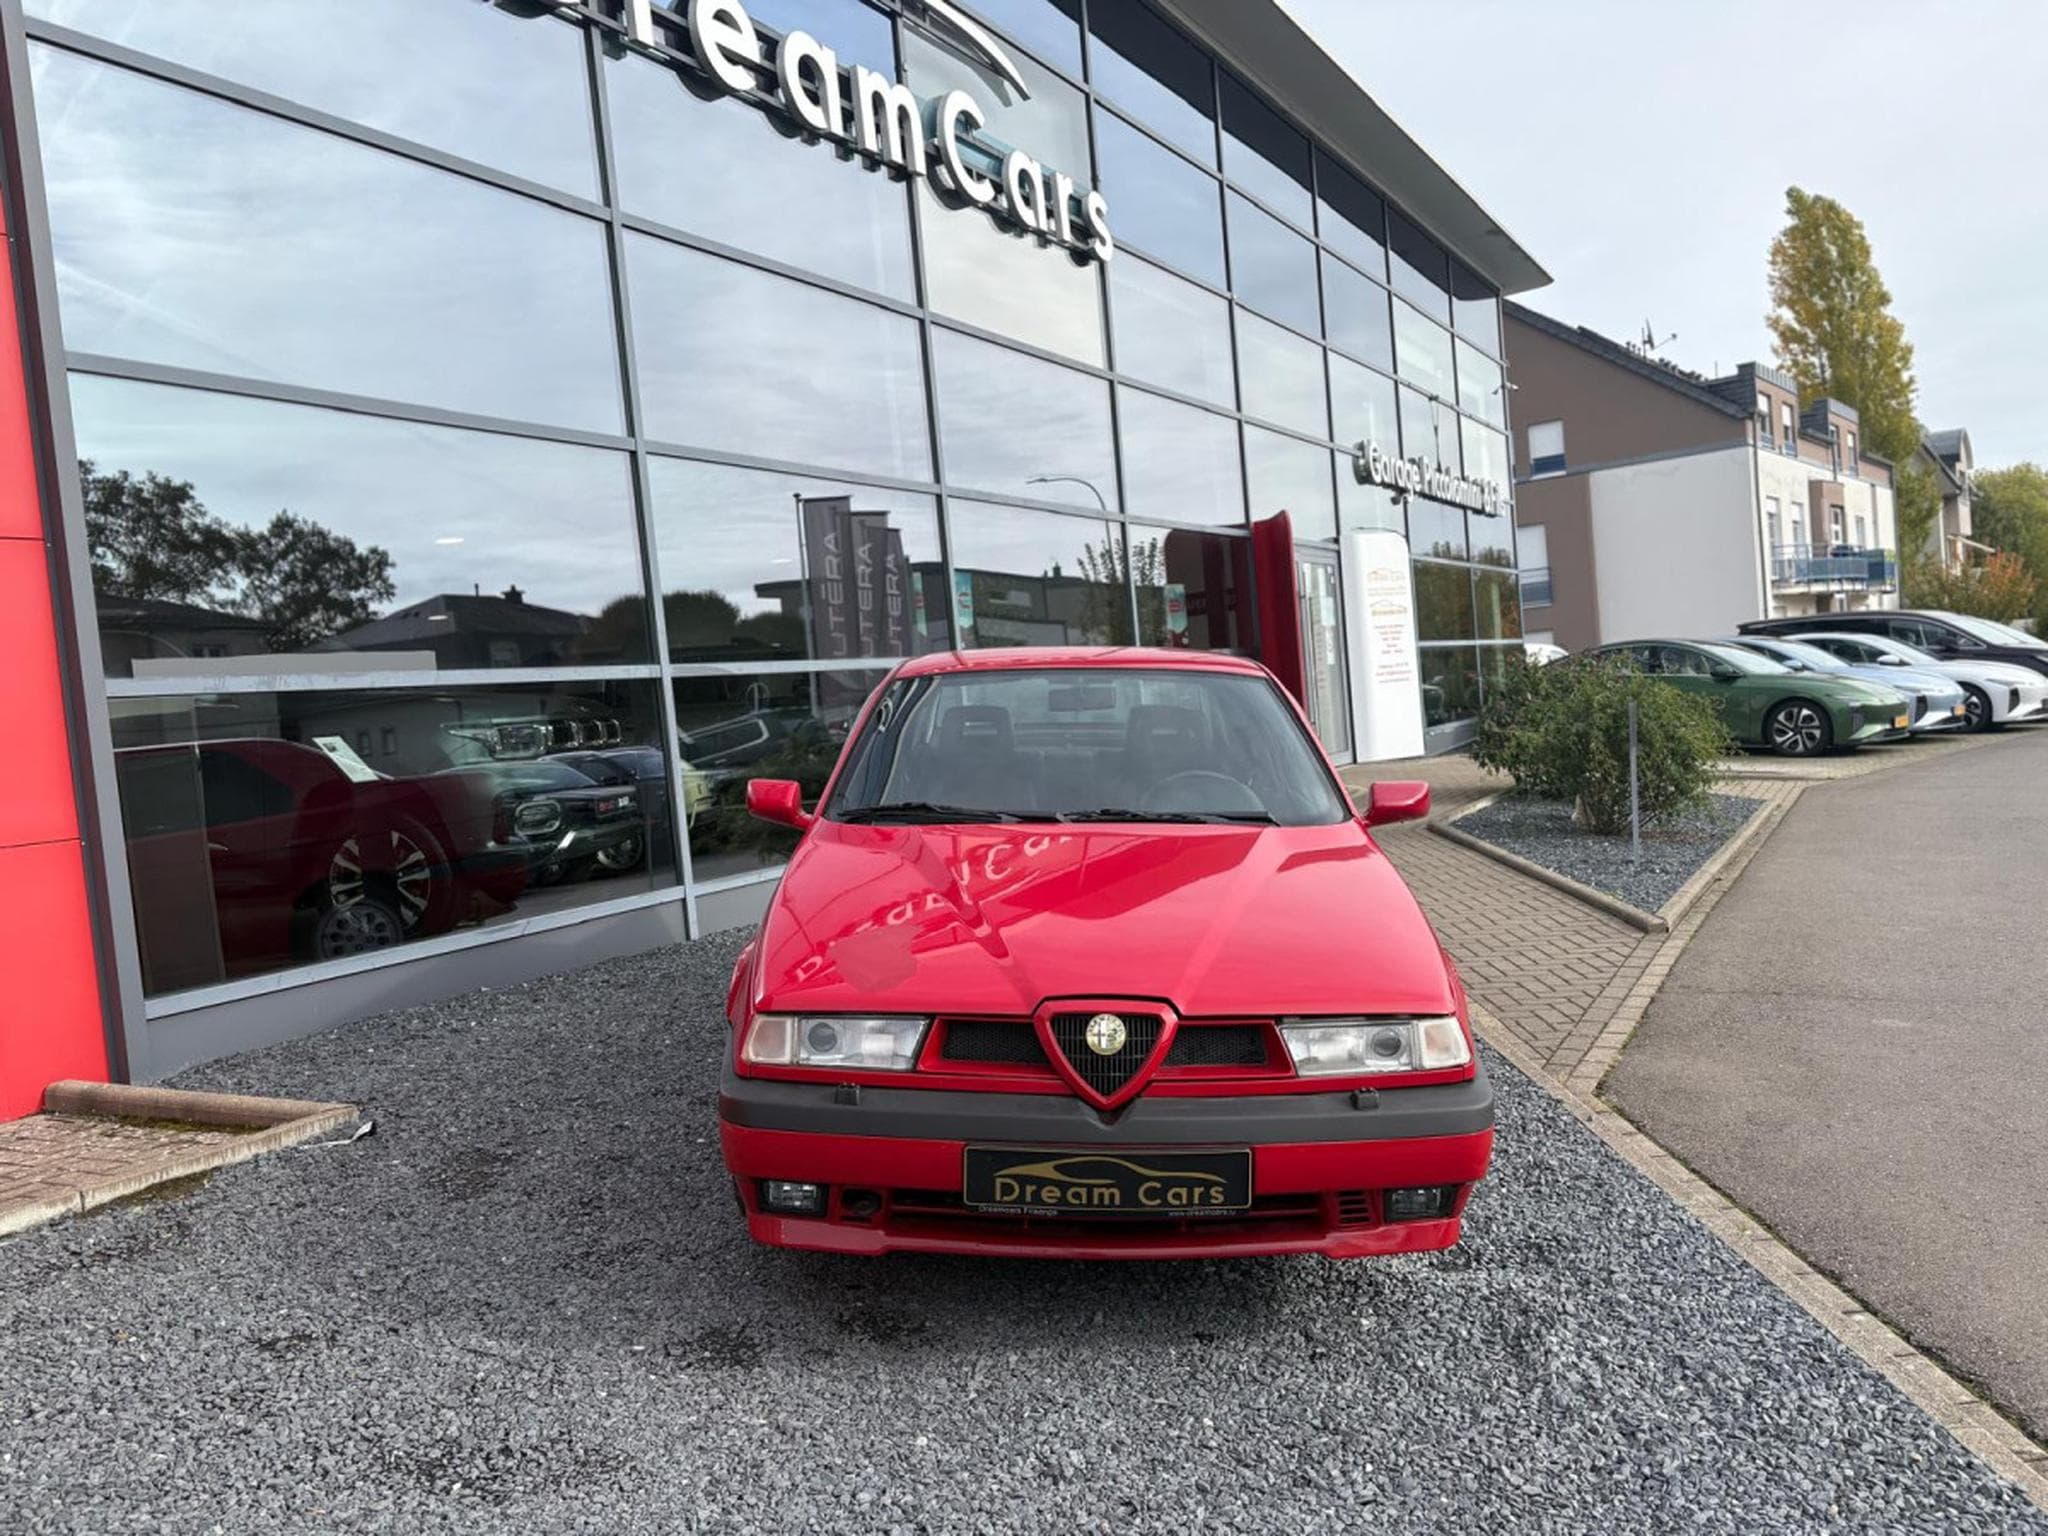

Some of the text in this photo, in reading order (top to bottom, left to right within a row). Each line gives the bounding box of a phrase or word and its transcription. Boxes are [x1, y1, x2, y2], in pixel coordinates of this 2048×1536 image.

[936, 90, 1114, 262] Cars
[1368, 440, 1422, 502] Garage
[994, 1177, 1225, 1205] Dream Cars
